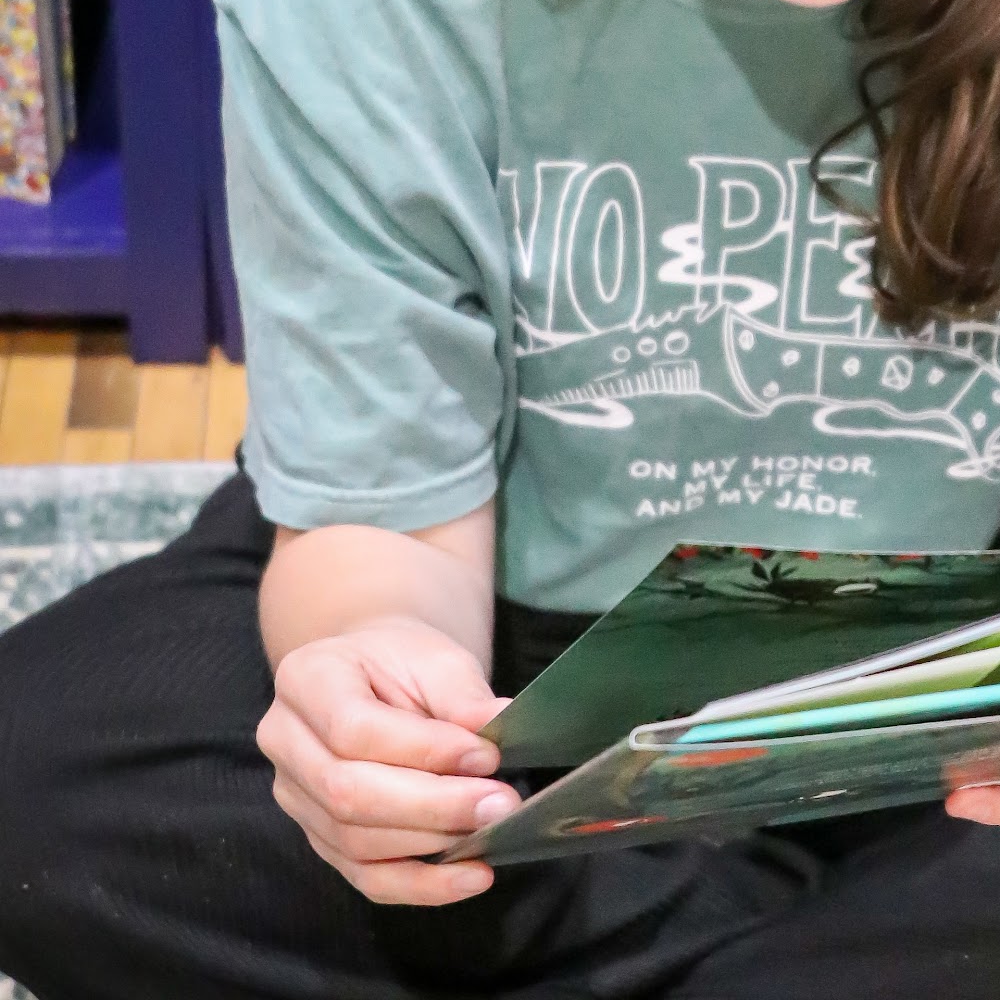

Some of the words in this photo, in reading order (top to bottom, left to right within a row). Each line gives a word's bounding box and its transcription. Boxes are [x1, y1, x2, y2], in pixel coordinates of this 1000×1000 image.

[629, 460, 677, 480] ON
[692, 457, 738, 478] MY
[684, 475, 729, 497] MY
[637, 497, 704, 518] AND
[718, 489, 764, 505] MY
